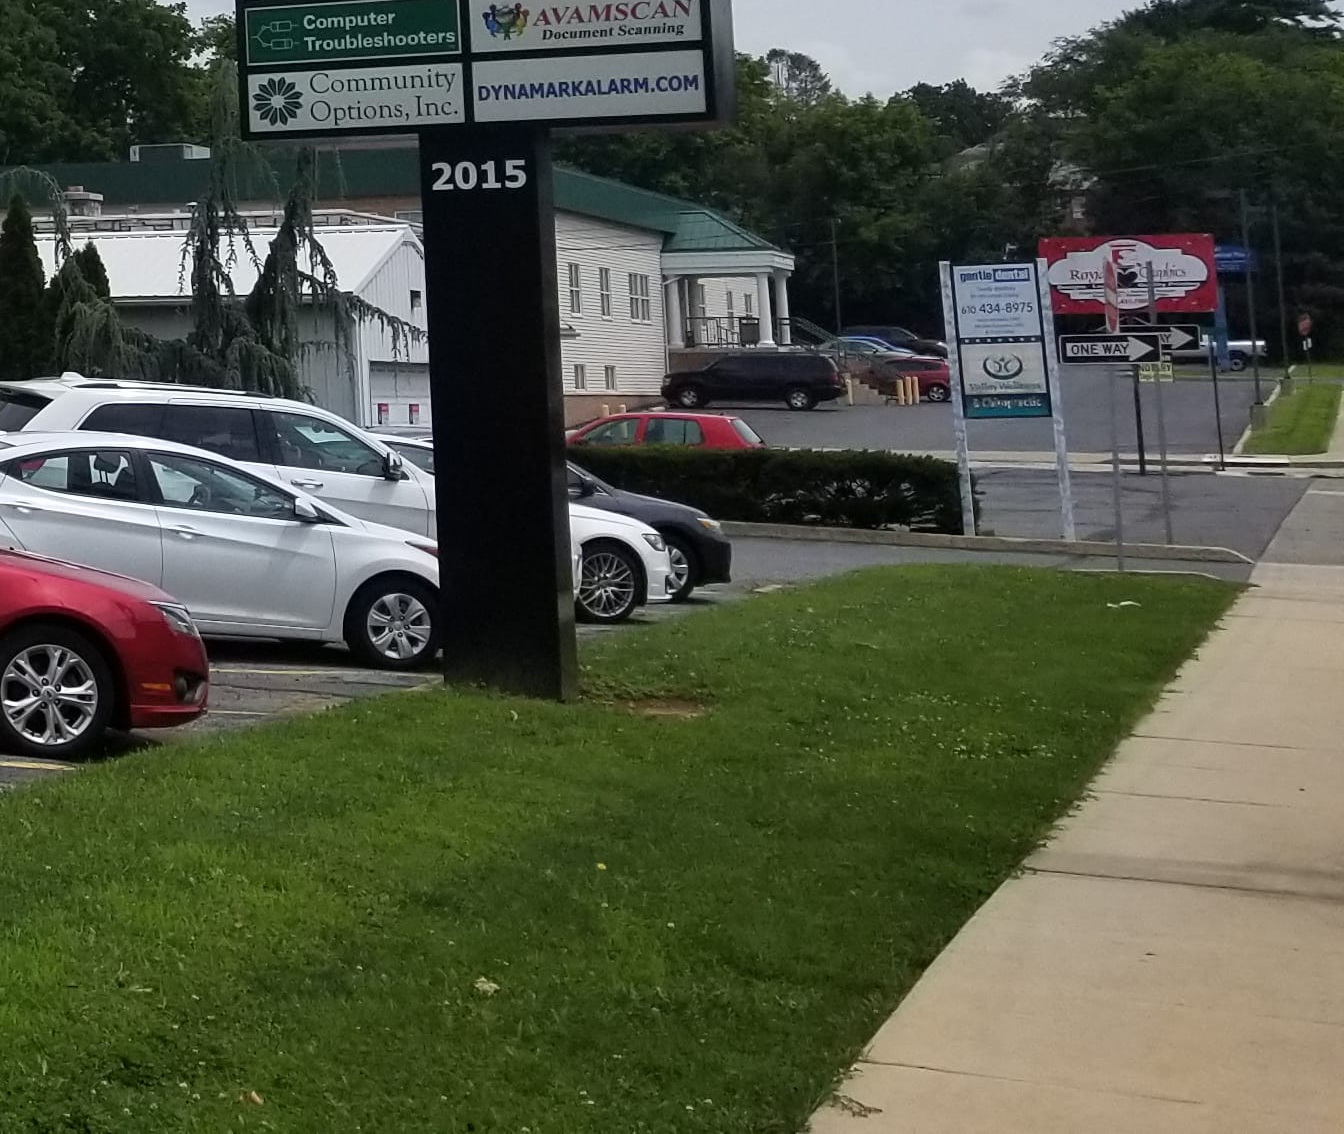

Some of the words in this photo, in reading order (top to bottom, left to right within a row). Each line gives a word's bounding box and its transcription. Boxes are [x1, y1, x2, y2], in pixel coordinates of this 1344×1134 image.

[303, 11, 396, 30] Computer
[304, 30, 456, 52] Troubleshooters
[542, 26, 613, 41] Document
[617, 23, 685, 37] Scanning
[310, 68, 457, 93] Community
[478, 74, 700, 101] DYNAMARKALARM.COM
[310, 100, 410, 126] Options,
[415, 95, 459, 117] Inc.
[431, 160, 527, 191] 2015
[961, 306, 977, 315] 610
[979, 302, 1034, 315] 434-8975
[1071, 344, 1099, 355] ONE
[1101, 343, 1129, 354] WAY
